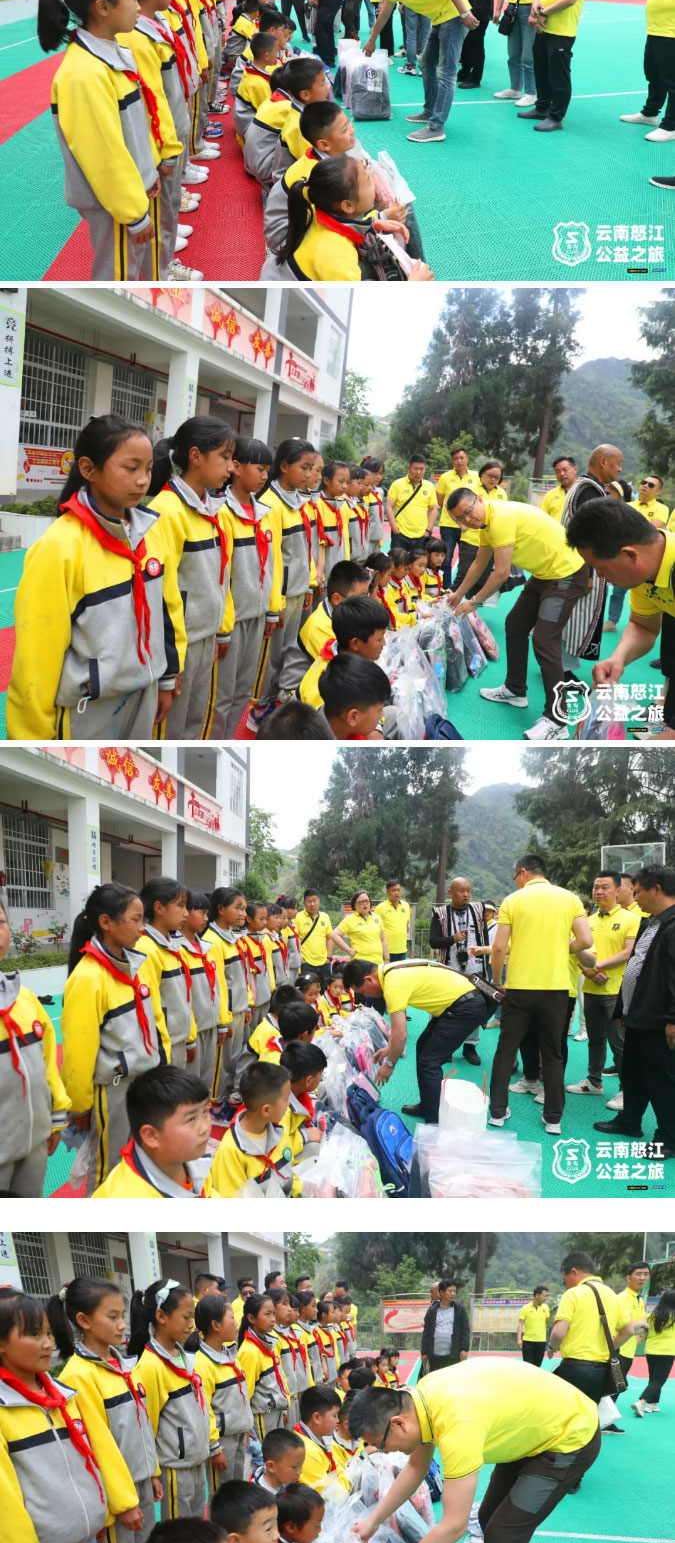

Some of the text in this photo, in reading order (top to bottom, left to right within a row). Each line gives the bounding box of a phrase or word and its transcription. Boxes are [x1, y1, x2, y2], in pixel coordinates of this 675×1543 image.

[210, 306, 272, 357] 诚信 友善
[105, 750, 174, 800] 诚信 友善
